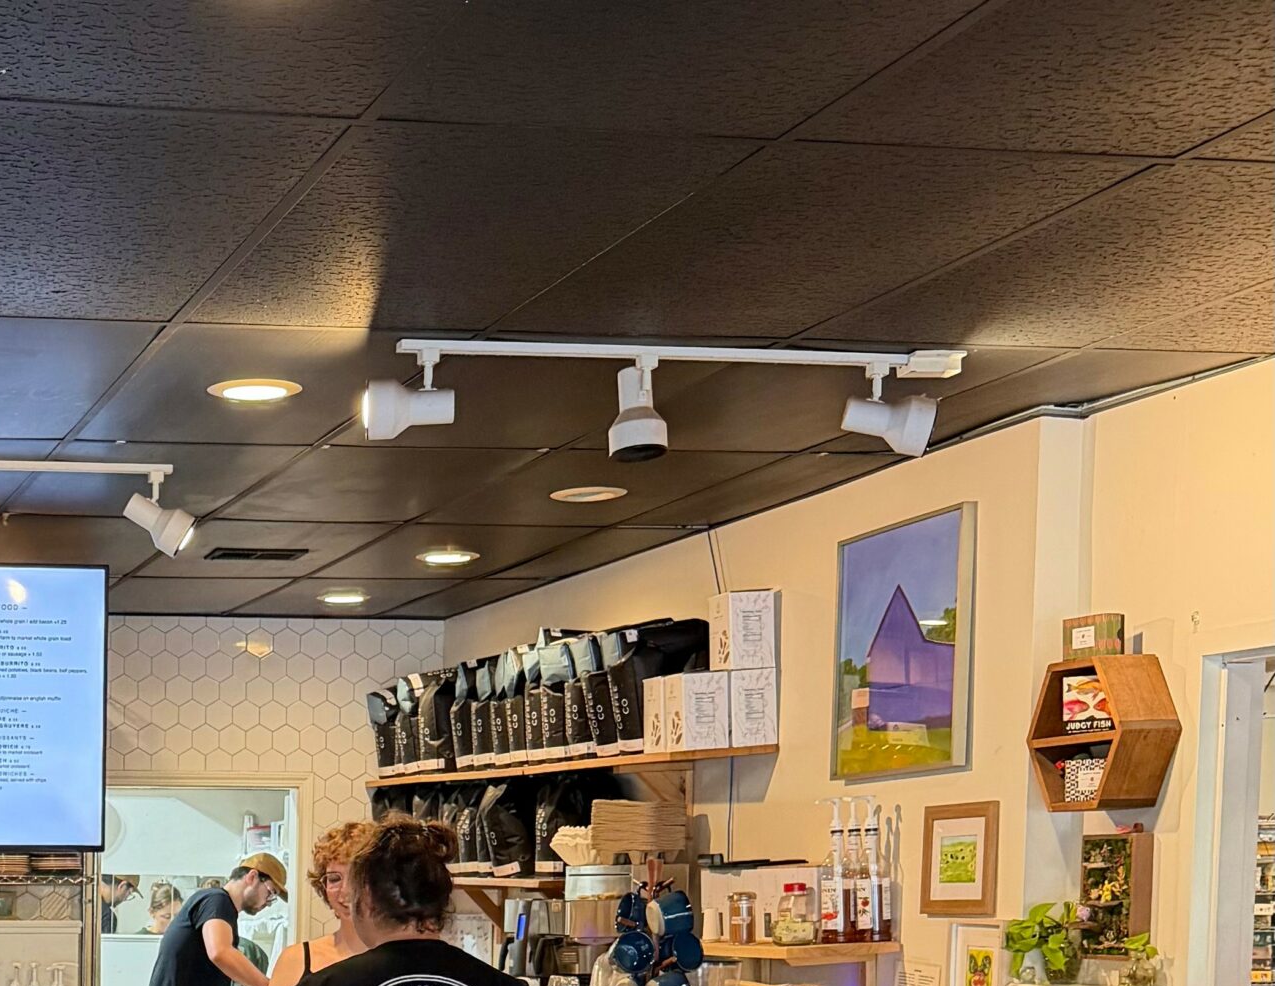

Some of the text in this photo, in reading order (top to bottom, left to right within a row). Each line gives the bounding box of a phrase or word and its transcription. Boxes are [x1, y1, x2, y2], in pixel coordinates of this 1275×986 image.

[572, 704, 579, 720] CO
[596, 704, 605, 721] CO
[612, 685, 623, 730] COFFEE
[621, 698, 630, 715] CO
[512, 714, 518, 729] CO
[531, 711, 538, 726] CO
[549, 708, 556, 724] CO
[1065, 719, 1112, 731] JUDGY FISH
